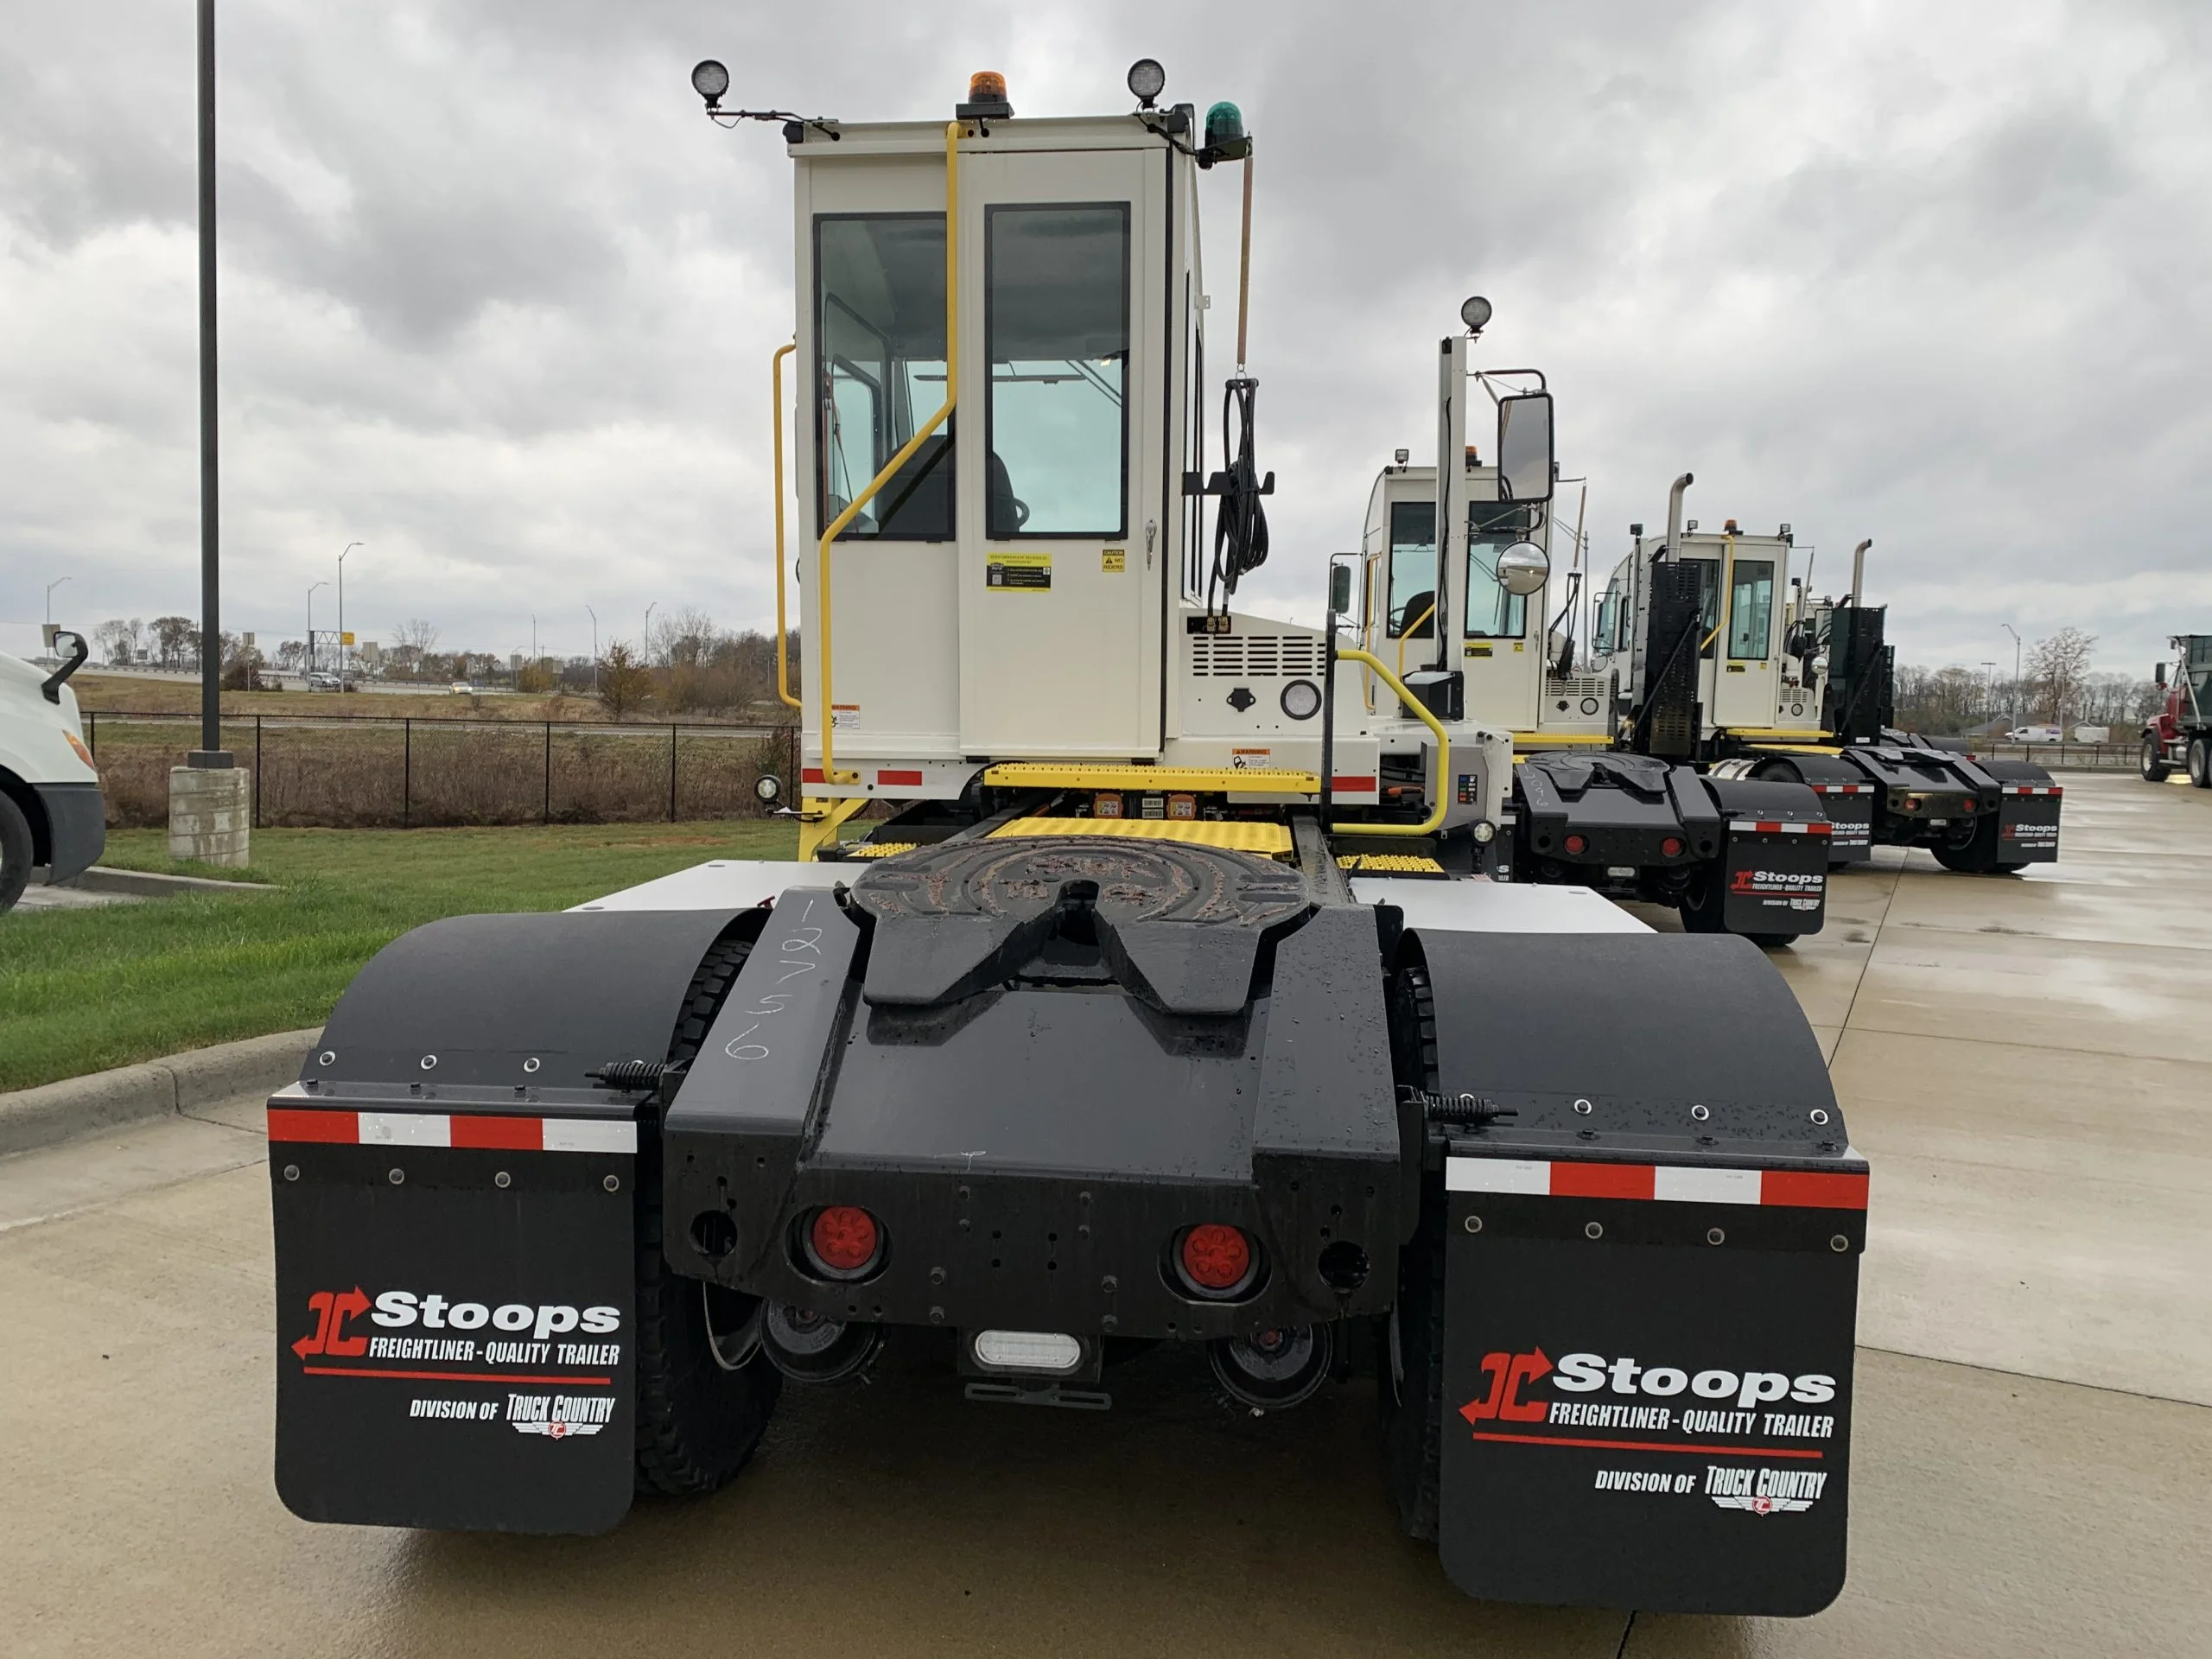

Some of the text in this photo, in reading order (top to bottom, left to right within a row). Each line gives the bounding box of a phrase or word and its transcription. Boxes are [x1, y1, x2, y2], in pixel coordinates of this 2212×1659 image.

[2015, 823, 2058, 832] Stoops
[1753, 870, 1824, 885] Stoops
[372, 1291, 620, 1339] Stoops
[557, 1344, 620, 1365] TRAILER
[1552, 1353, 1836, 1408] Stoops
[410, 1393, 616, 1423] DIVISION OF TRUCK COUNTRY
[1764, 1413, 1834, 1439] TRAILER
[1595, 1465, 1827, 1499] DIVISION OF TRUCK COUNTRY
